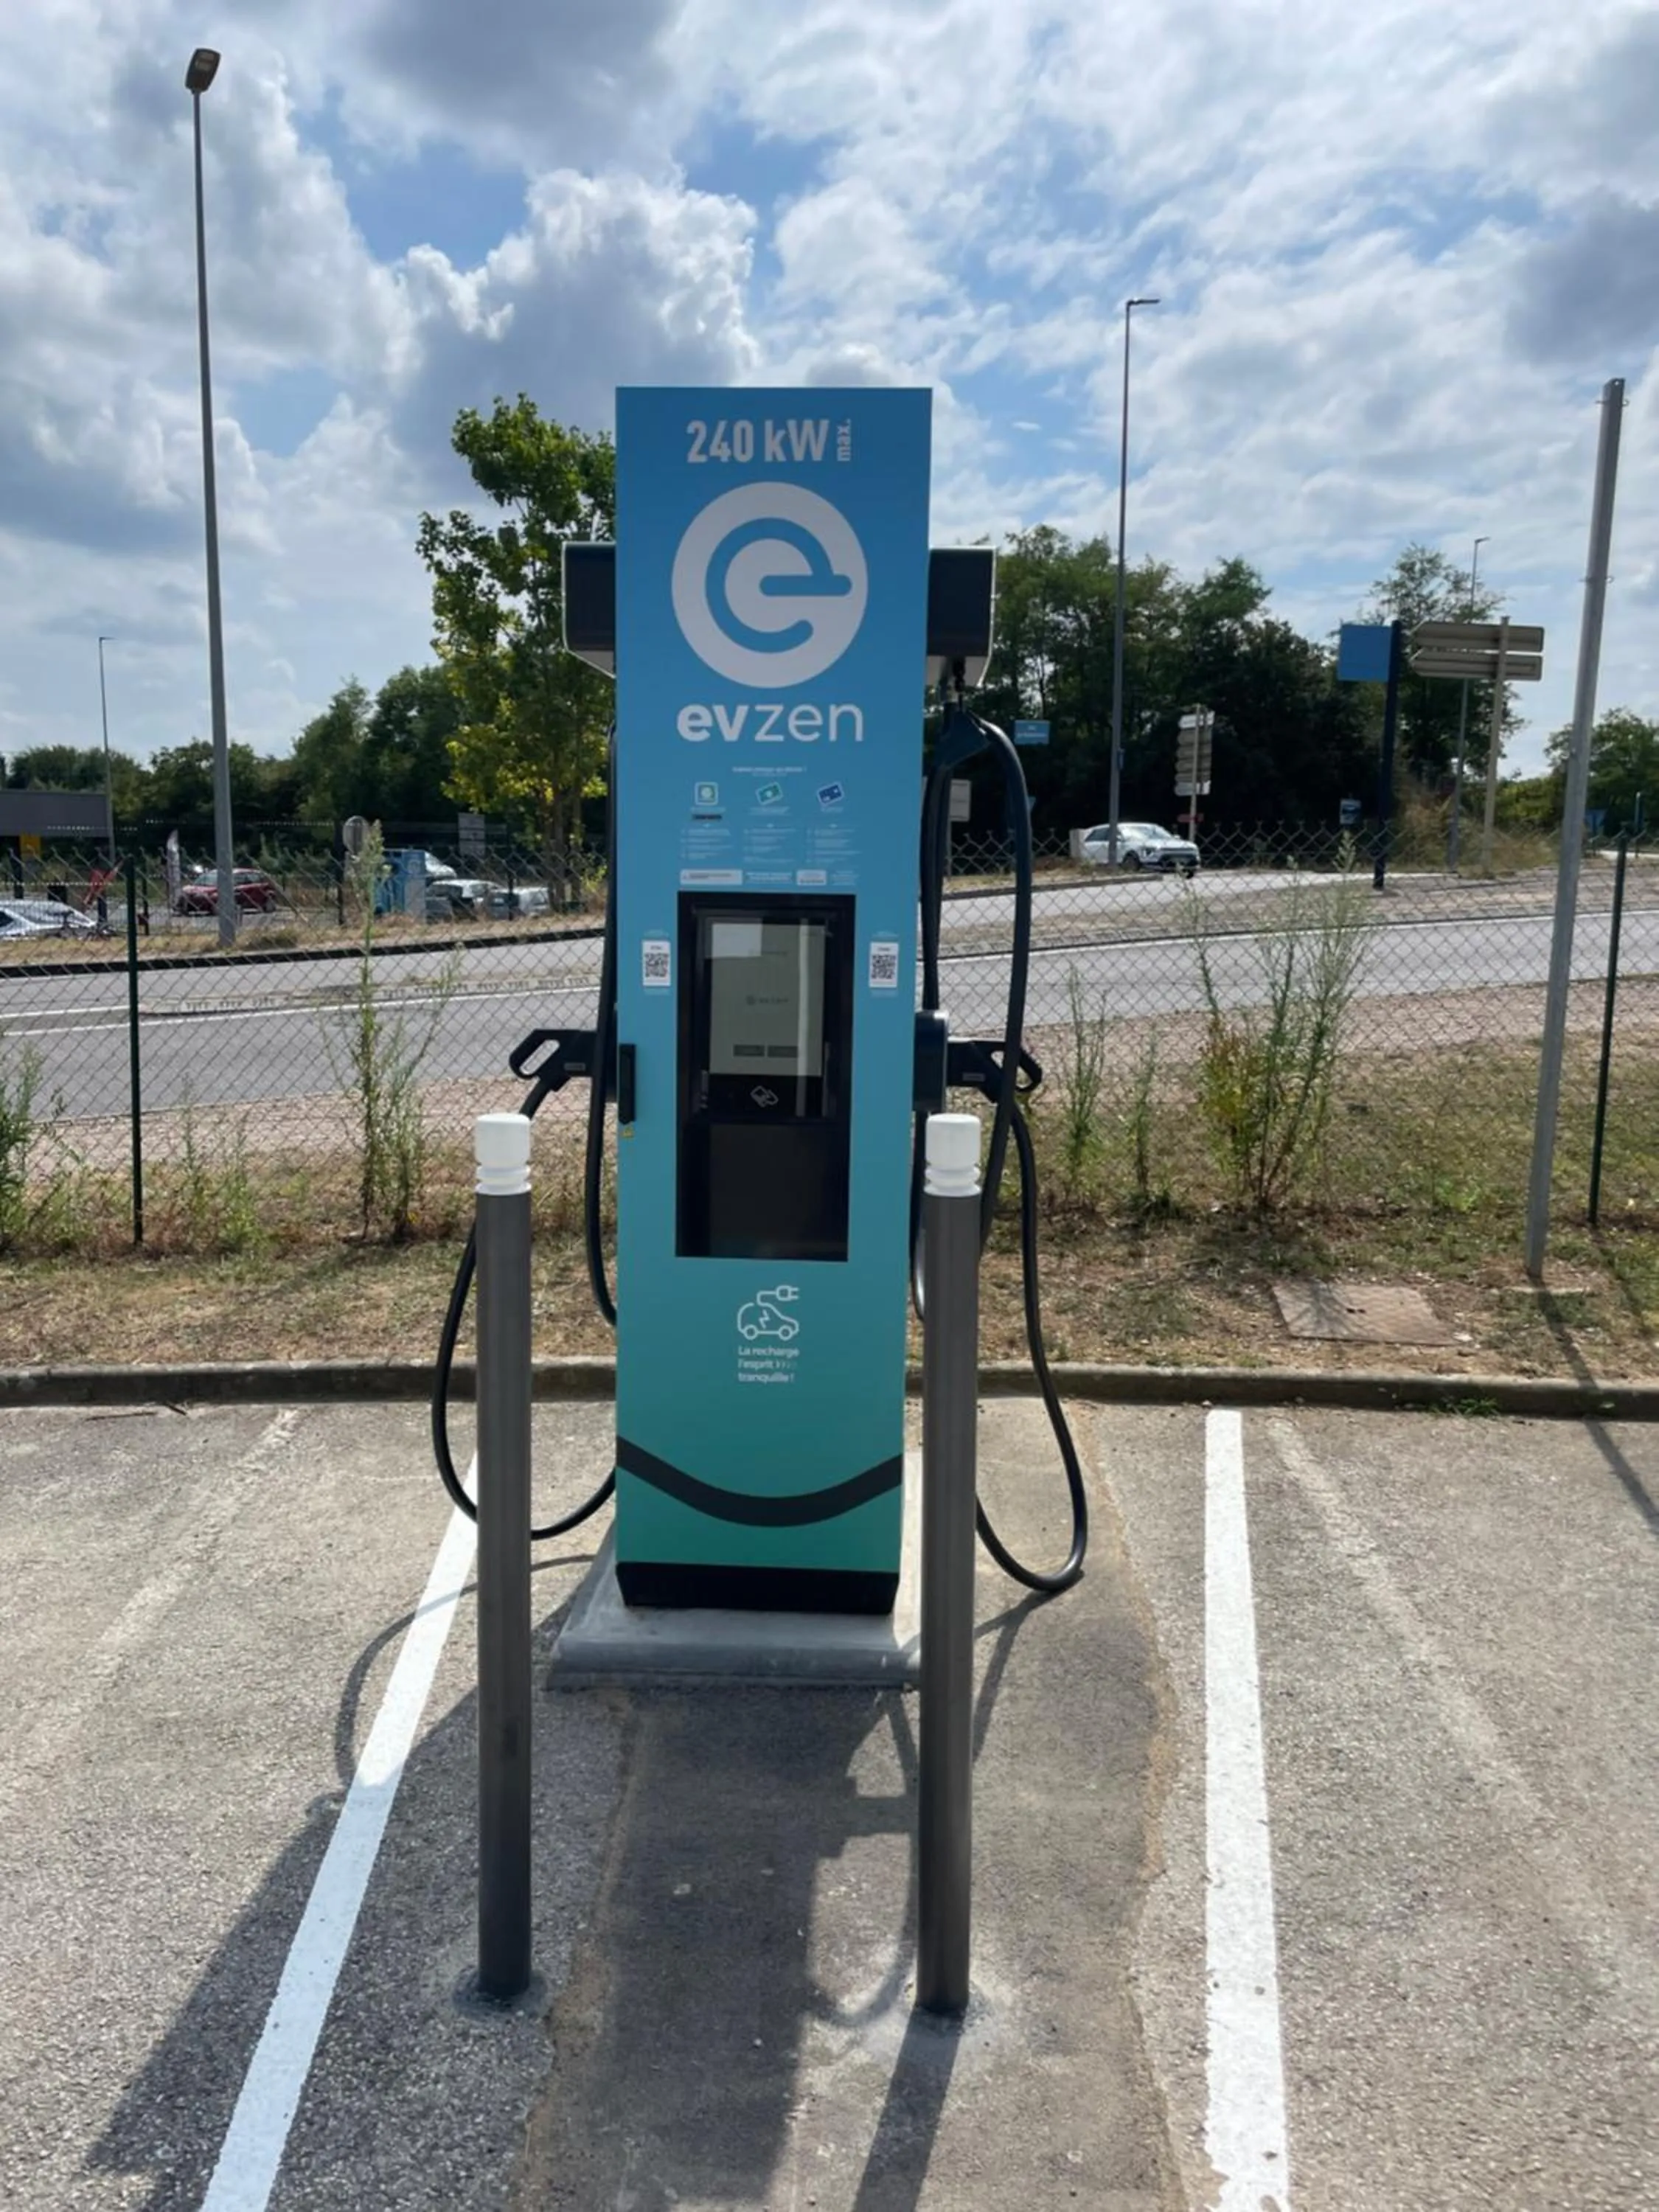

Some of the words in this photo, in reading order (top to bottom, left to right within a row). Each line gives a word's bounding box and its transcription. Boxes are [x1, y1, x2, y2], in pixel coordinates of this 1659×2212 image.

[686, 419, 754, 463] 240
[765, 419, 829, 462] kW
[836, 418, 852, 462] max.
[676, 703, 863, 742] evzen
[738, 1346, 751, 1356] La
[752, 1346, 800, 1358] recharge
